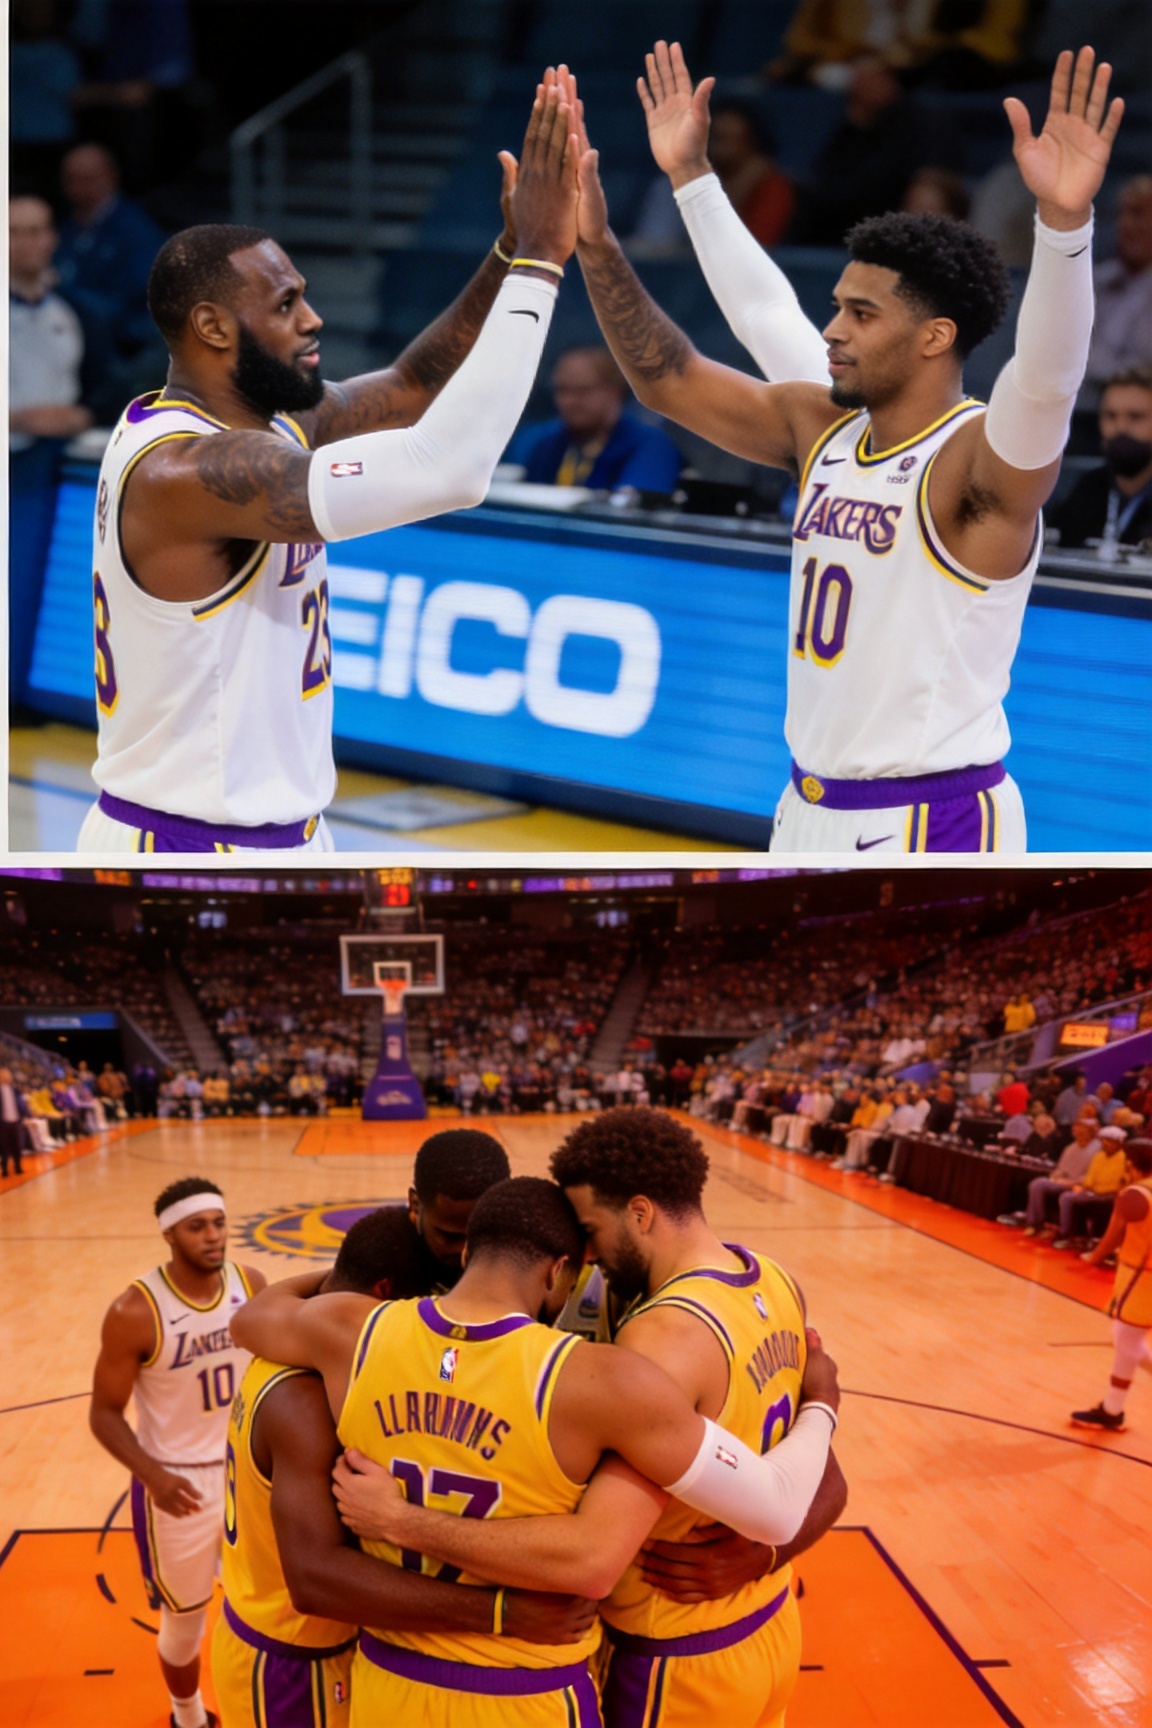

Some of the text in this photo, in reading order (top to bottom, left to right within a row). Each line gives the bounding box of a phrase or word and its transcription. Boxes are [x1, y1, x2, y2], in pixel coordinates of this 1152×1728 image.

[793, 483, 903, 556] LAKERS
[793, 556, 853, 670] 10
[196, 1363, 234, 1411] 10
